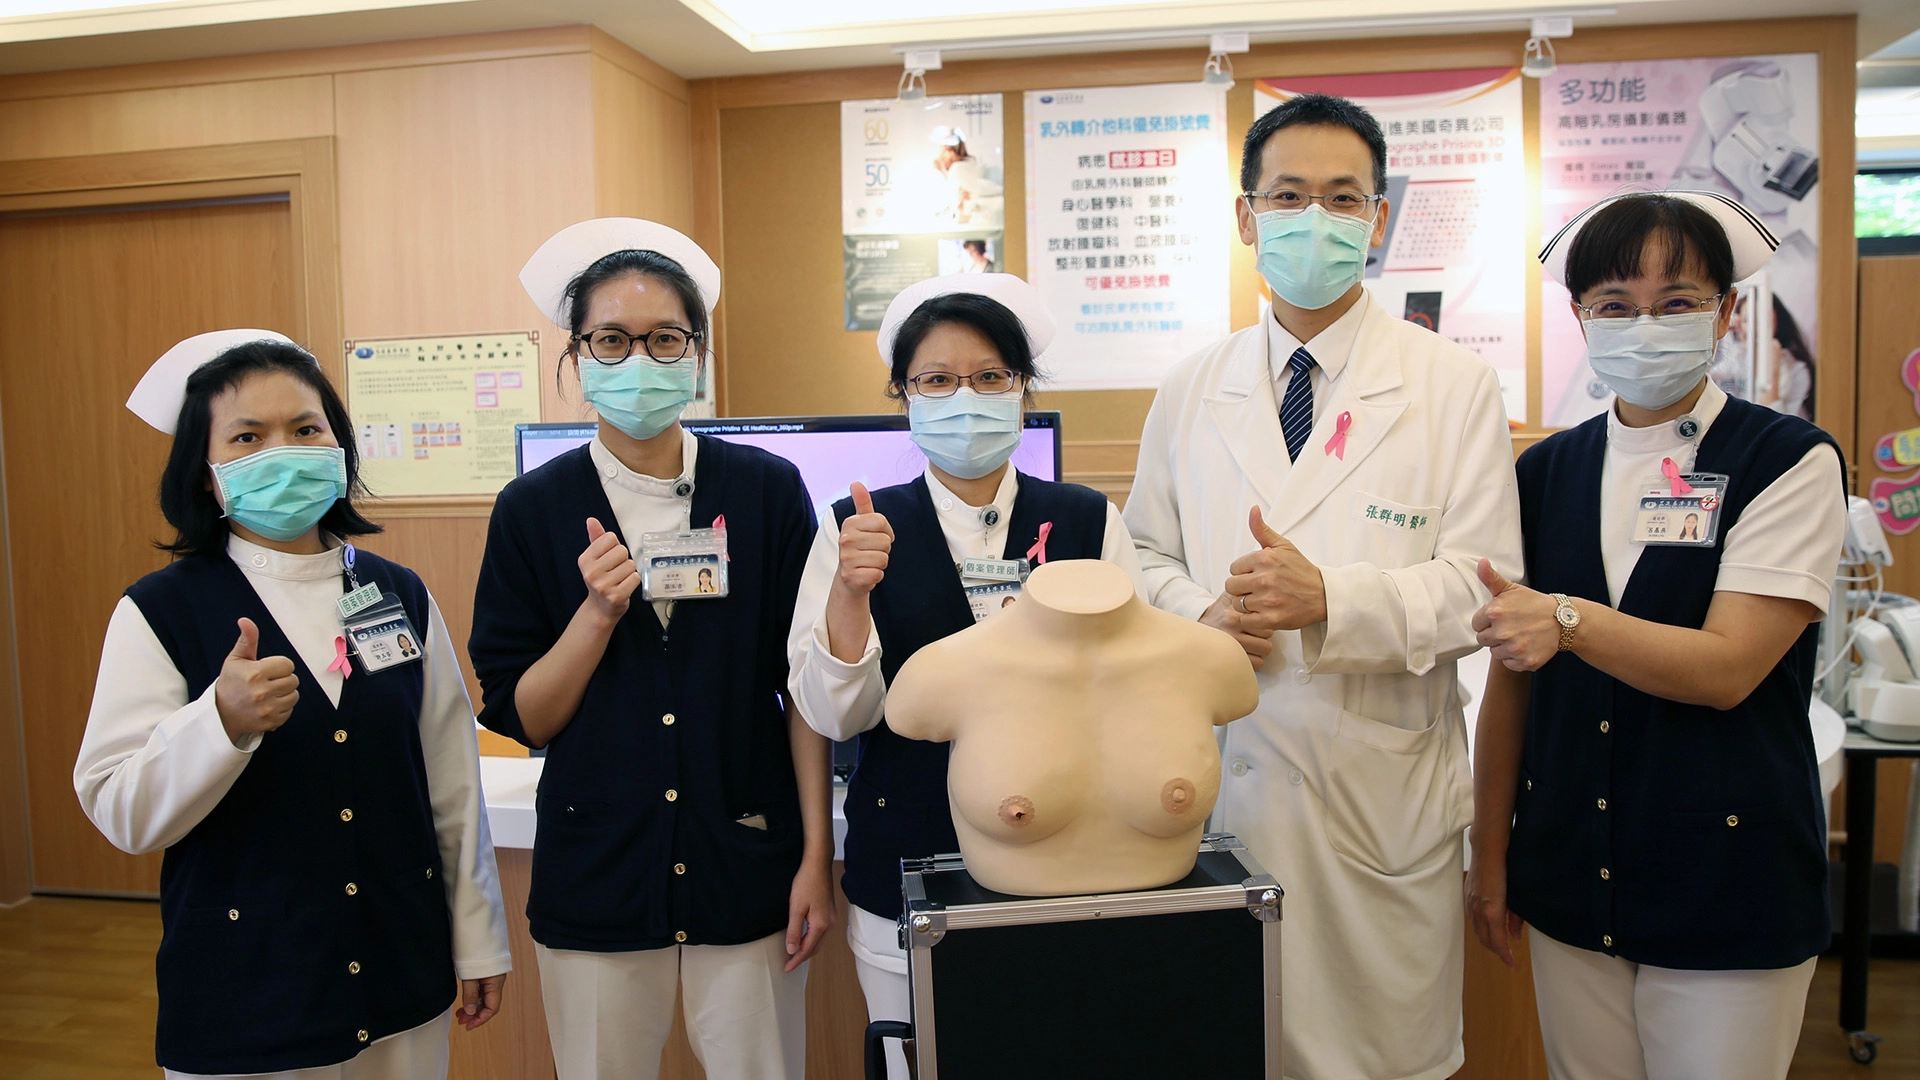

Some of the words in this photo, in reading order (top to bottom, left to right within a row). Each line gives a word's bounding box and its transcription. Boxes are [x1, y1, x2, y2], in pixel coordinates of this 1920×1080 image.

[1558, 76, 1647, 105] 多功能
[864, 117, 889, 142] 60
[865, 163, 890, 187] 50
[1148, 196, 1182, 207] 營養
[1366, 504, 1407, 527] 張群明
[966, 562, 1016, 576] 個案管理師
